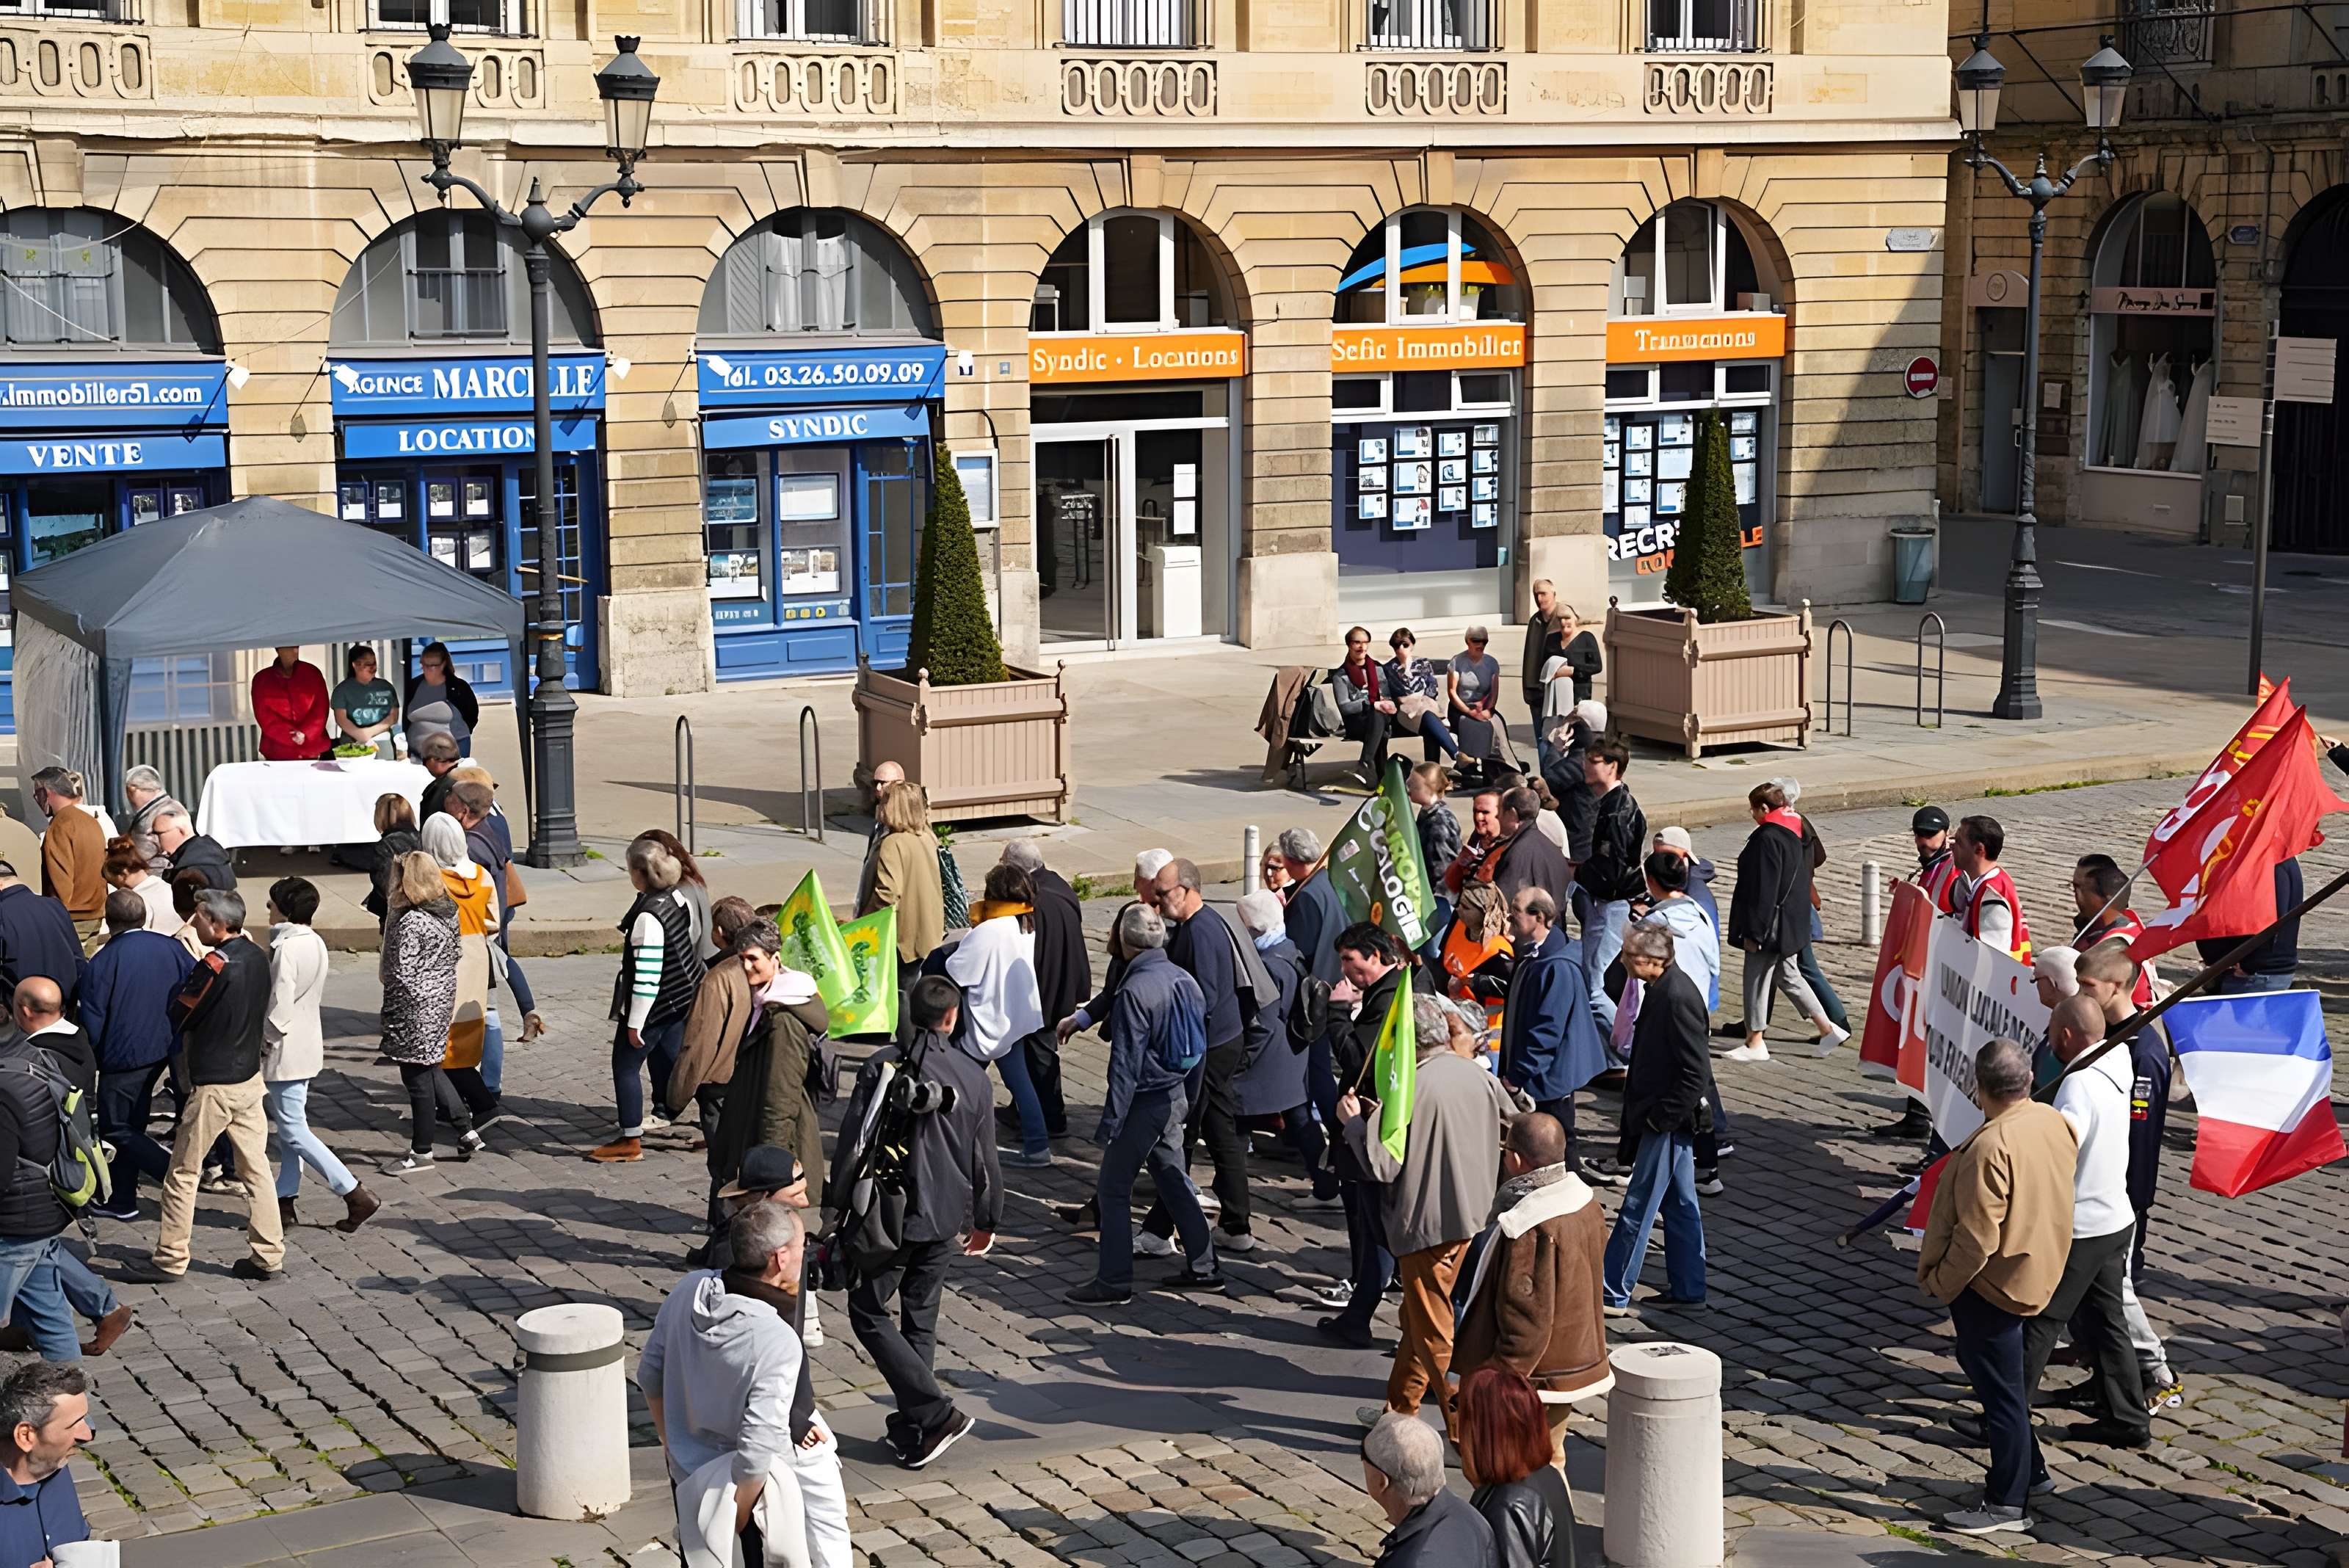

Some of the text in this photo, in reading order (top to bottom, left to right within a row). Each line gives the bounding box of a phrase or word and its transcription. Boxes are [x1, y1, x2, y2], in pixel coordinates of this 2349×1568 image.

[1397, 334, 1522, 360] Immobilier
[1033, 346, 1238, 376] Syndic Locations
[764, 363, 925, 386] 03.26.50.09.09
[769, 413, 868, 439] SYNDIC
[27, 442, 144, 468] VENTE
[1604, 519, 1681, 561] RECR
